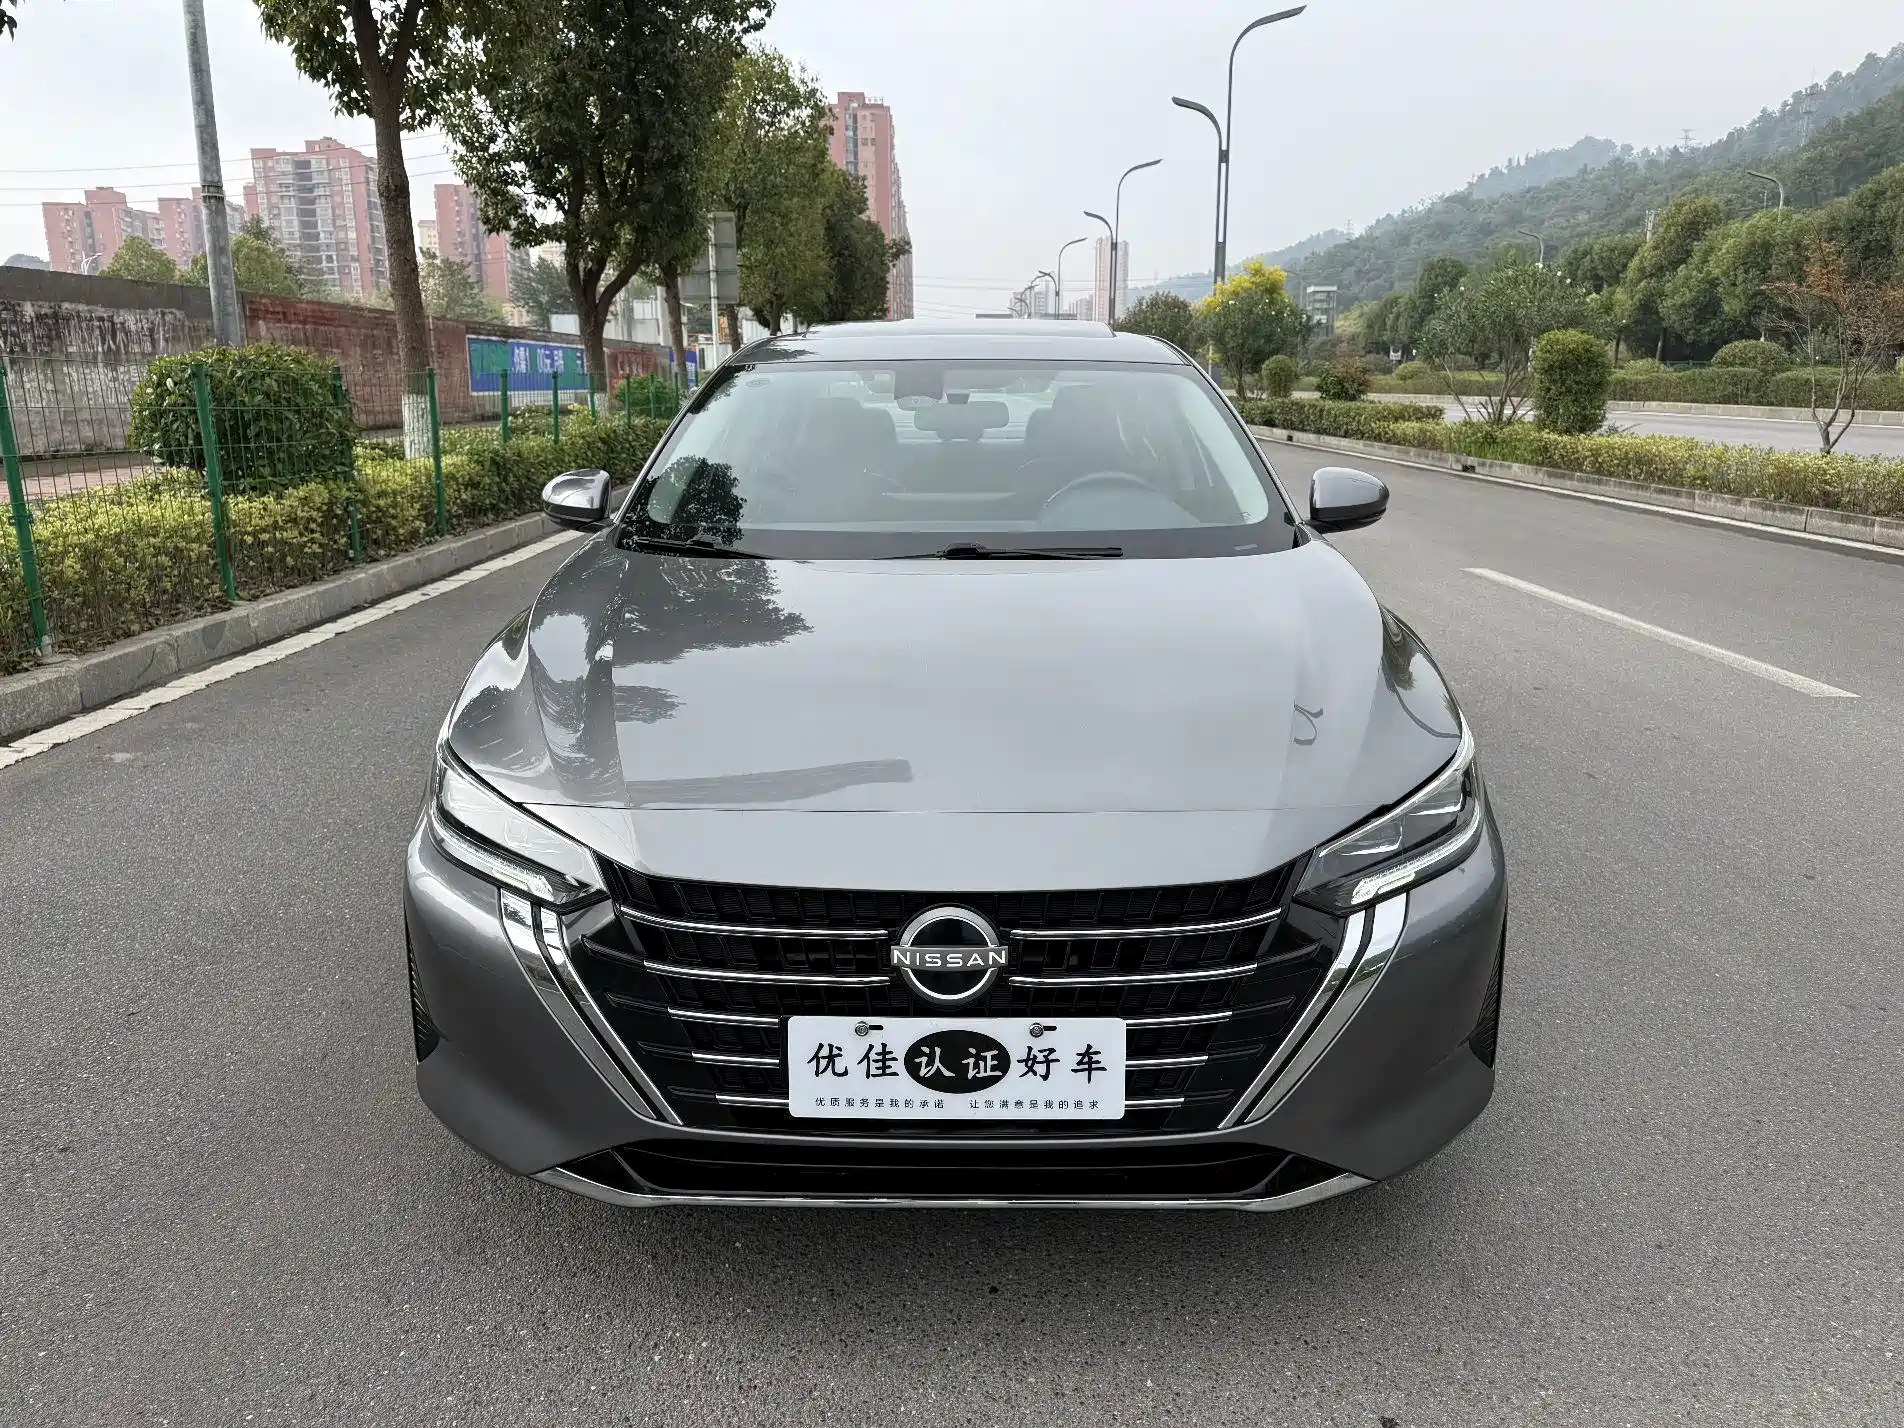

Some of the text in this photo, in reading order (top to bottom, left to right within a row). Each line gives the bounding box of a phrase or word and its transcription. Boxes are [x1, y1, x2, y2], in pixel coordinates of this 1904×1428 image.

[893, 949, 1006, 968] NISSAN
[806, 1042, 1108, 1084] 优佳认证好车
[815, 1096, 1100, 1110] 优质服务是我的承诺 让您满意是我的追求
